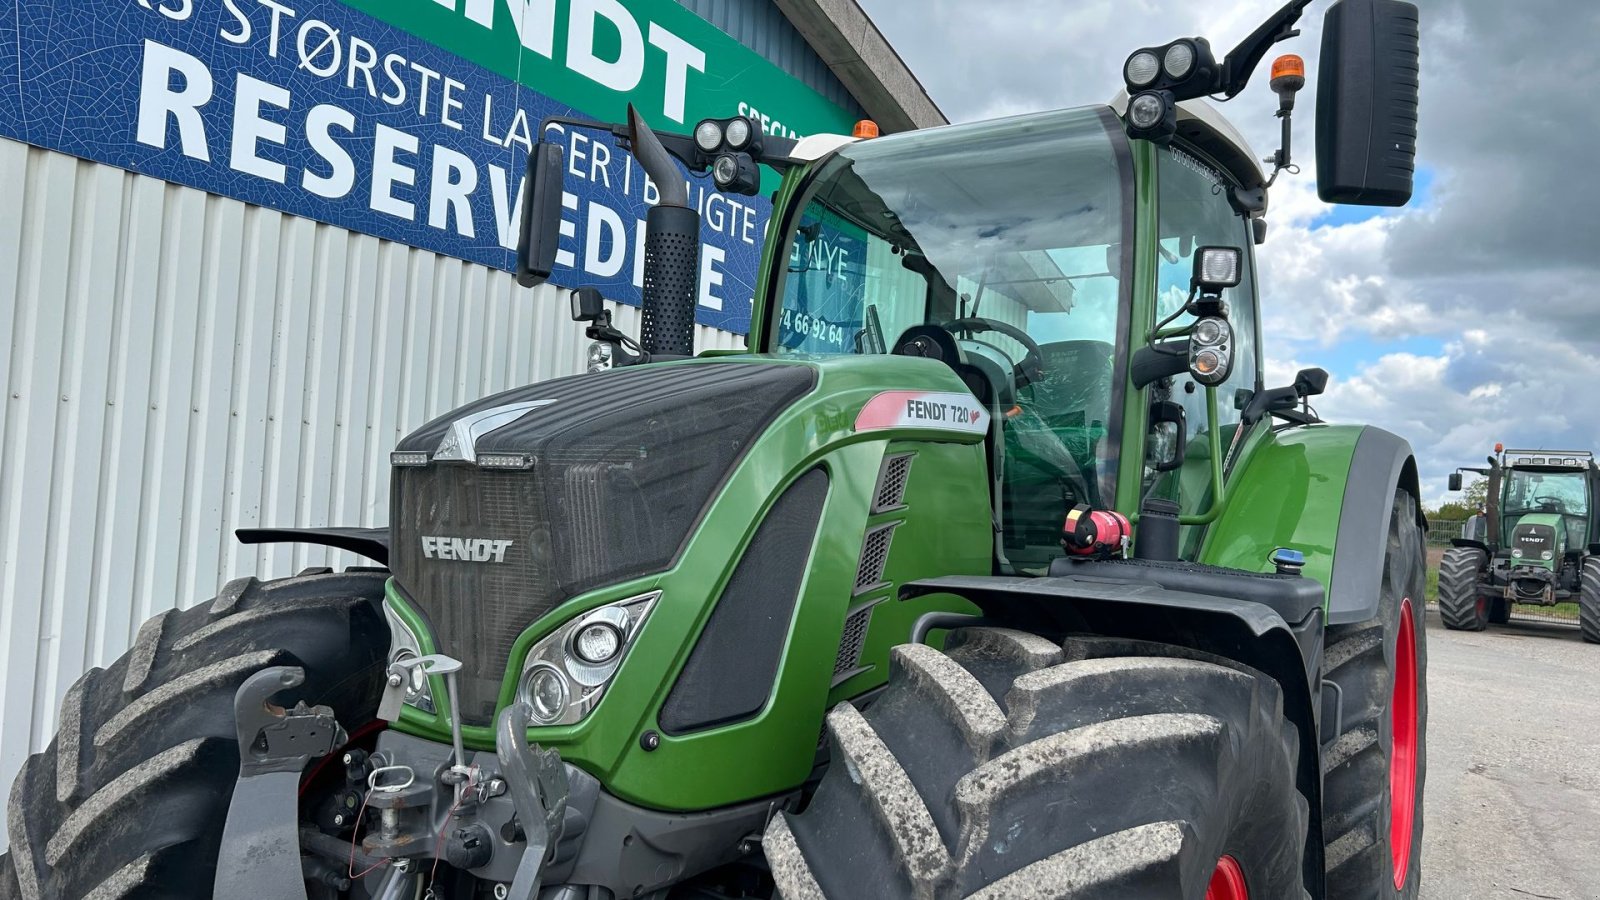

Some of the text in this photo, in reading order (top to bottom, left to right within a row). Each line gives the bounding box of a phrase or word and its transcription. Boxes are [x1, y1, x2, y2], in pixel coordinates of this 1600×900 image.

[220, 0, 466, 131] STØRSTE
[794, 312, 809, 335] 66
[812, 318, 826, 341] 92
[828, 324, 843, 346] 64
[907, 399, 969, 424] FENDT 720
[421, 536, 513, 562] FENDT
